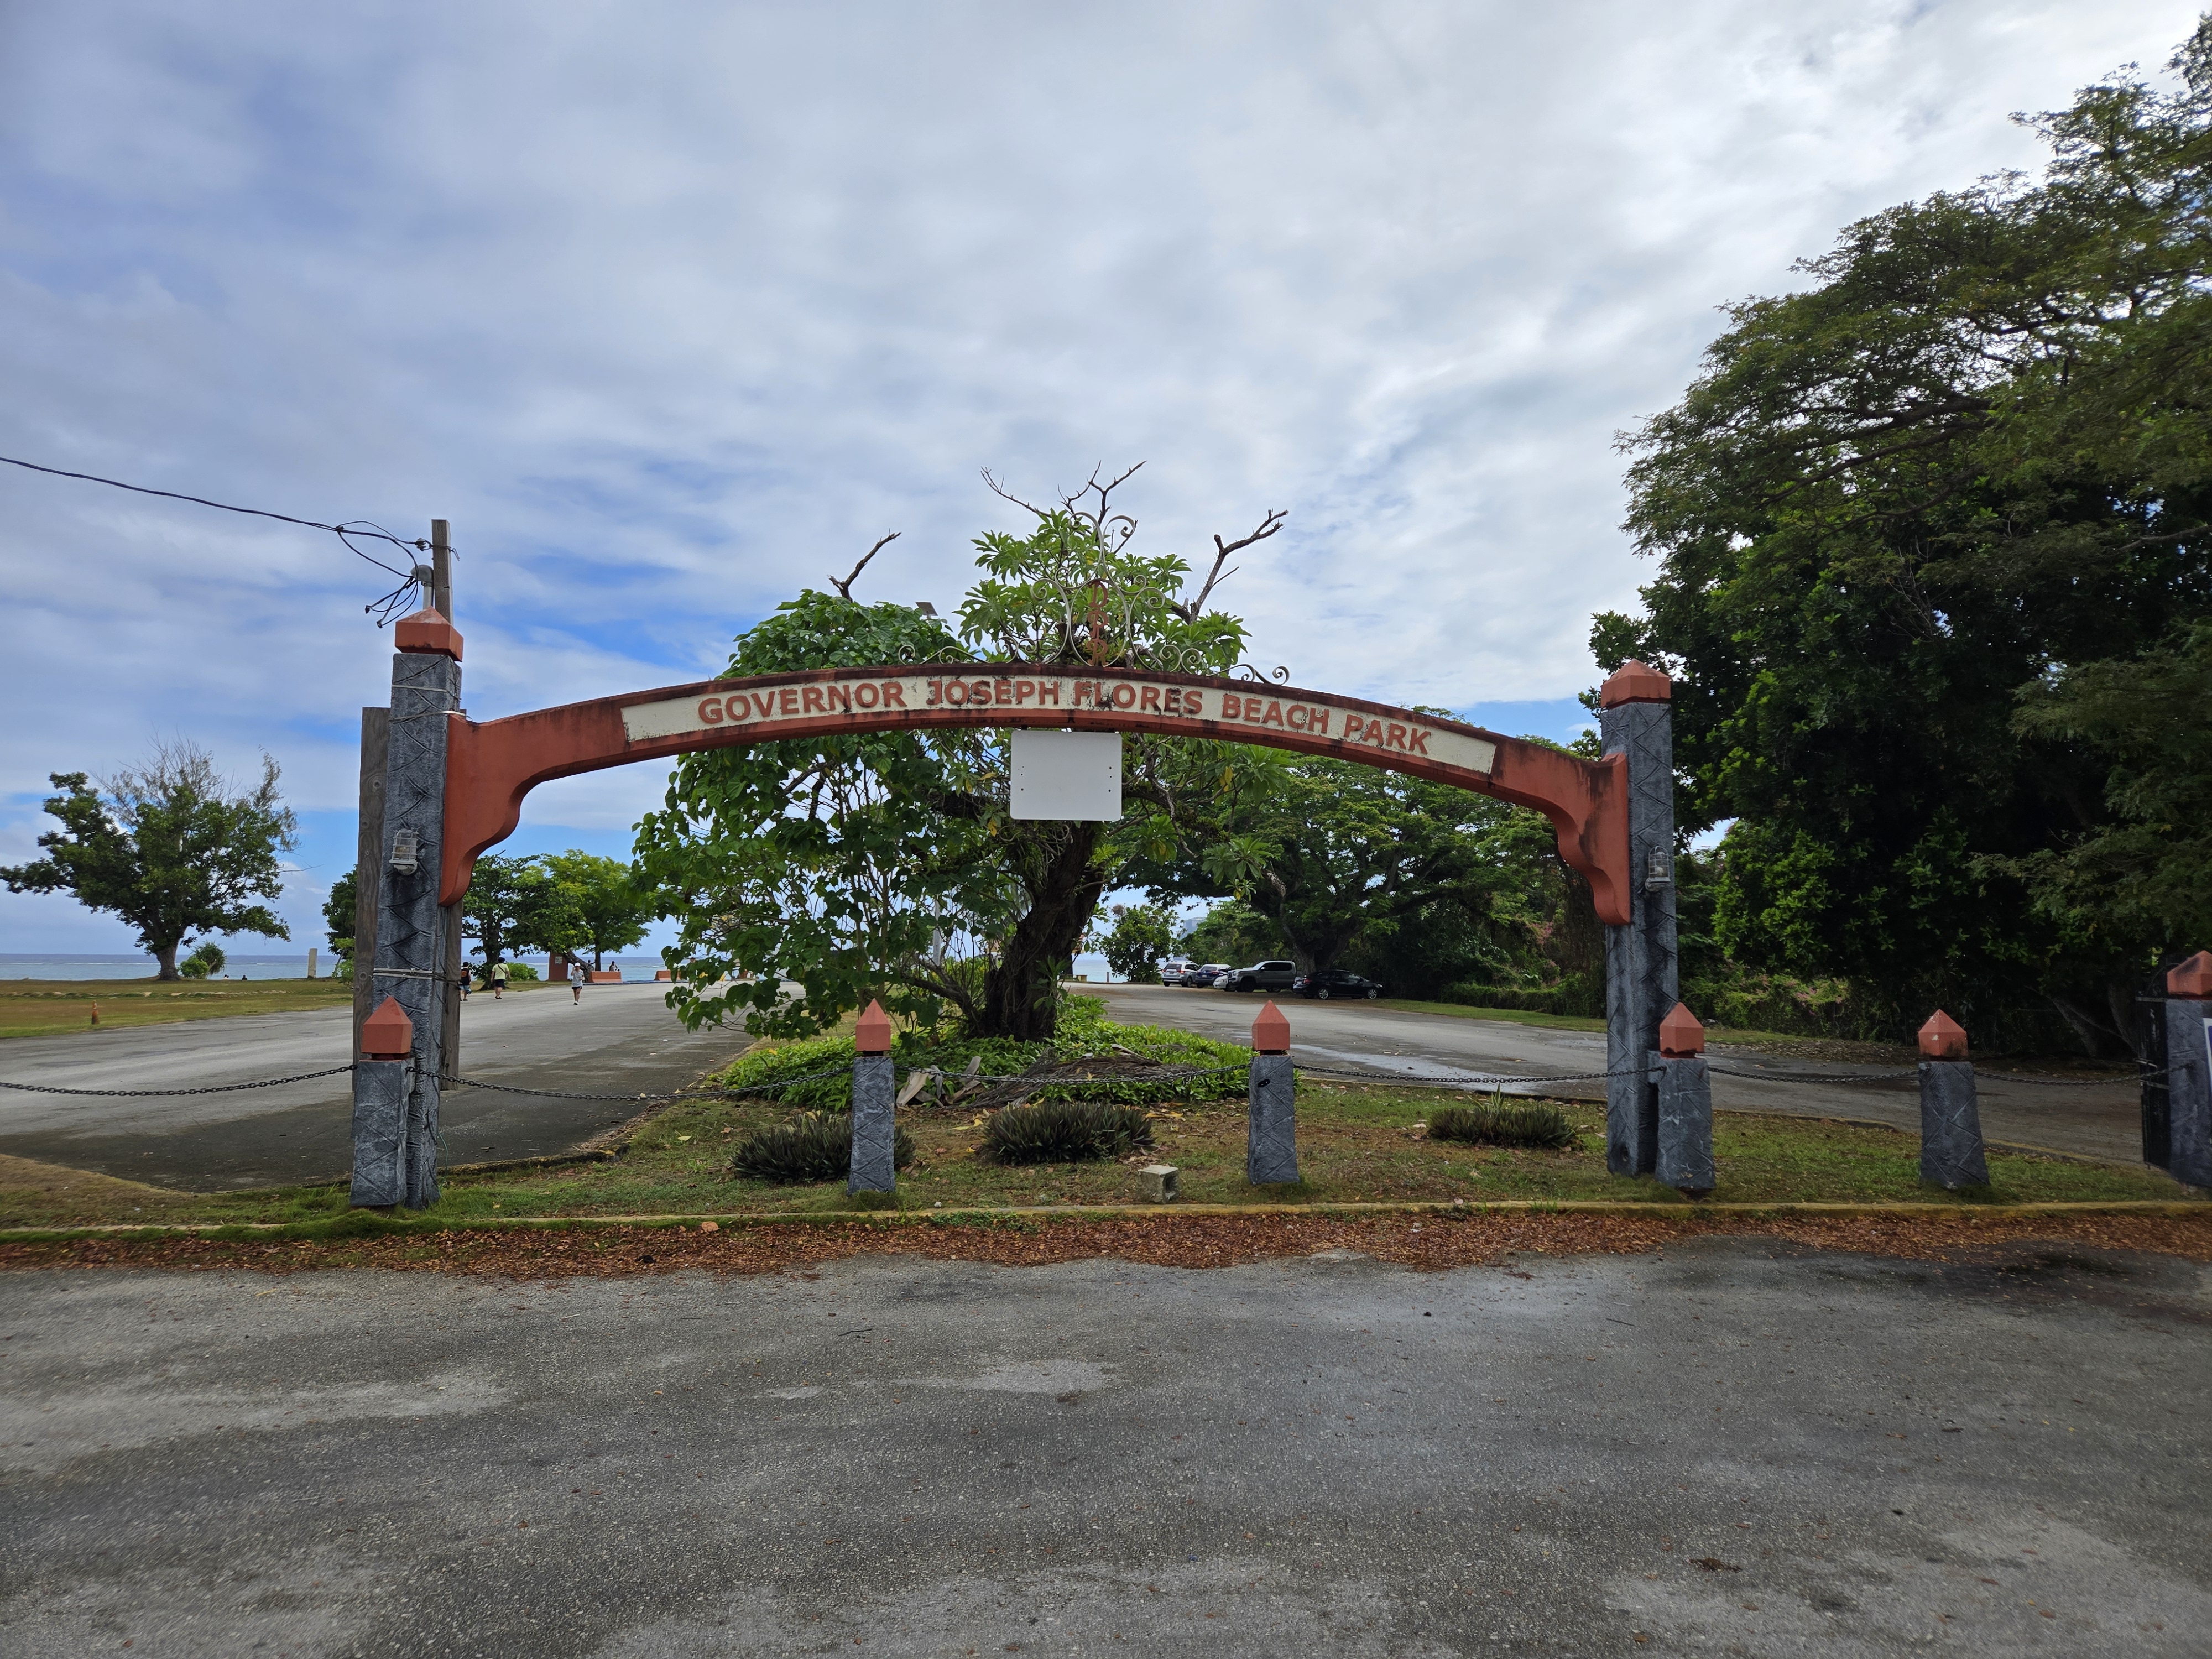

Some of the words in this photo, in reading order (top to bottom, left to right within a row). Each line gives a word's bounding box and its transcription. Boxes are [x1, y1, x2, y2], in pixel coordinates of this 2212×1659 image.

[698, 681, 907, 724] GOVERNOR
[925, 680, 1060, 706] JOSEPH
[1073, 681, 1203, 714] FLORES
[1222, 693, 1330, 734] BEACH
[1343, 714, 1431, 755] PARK
